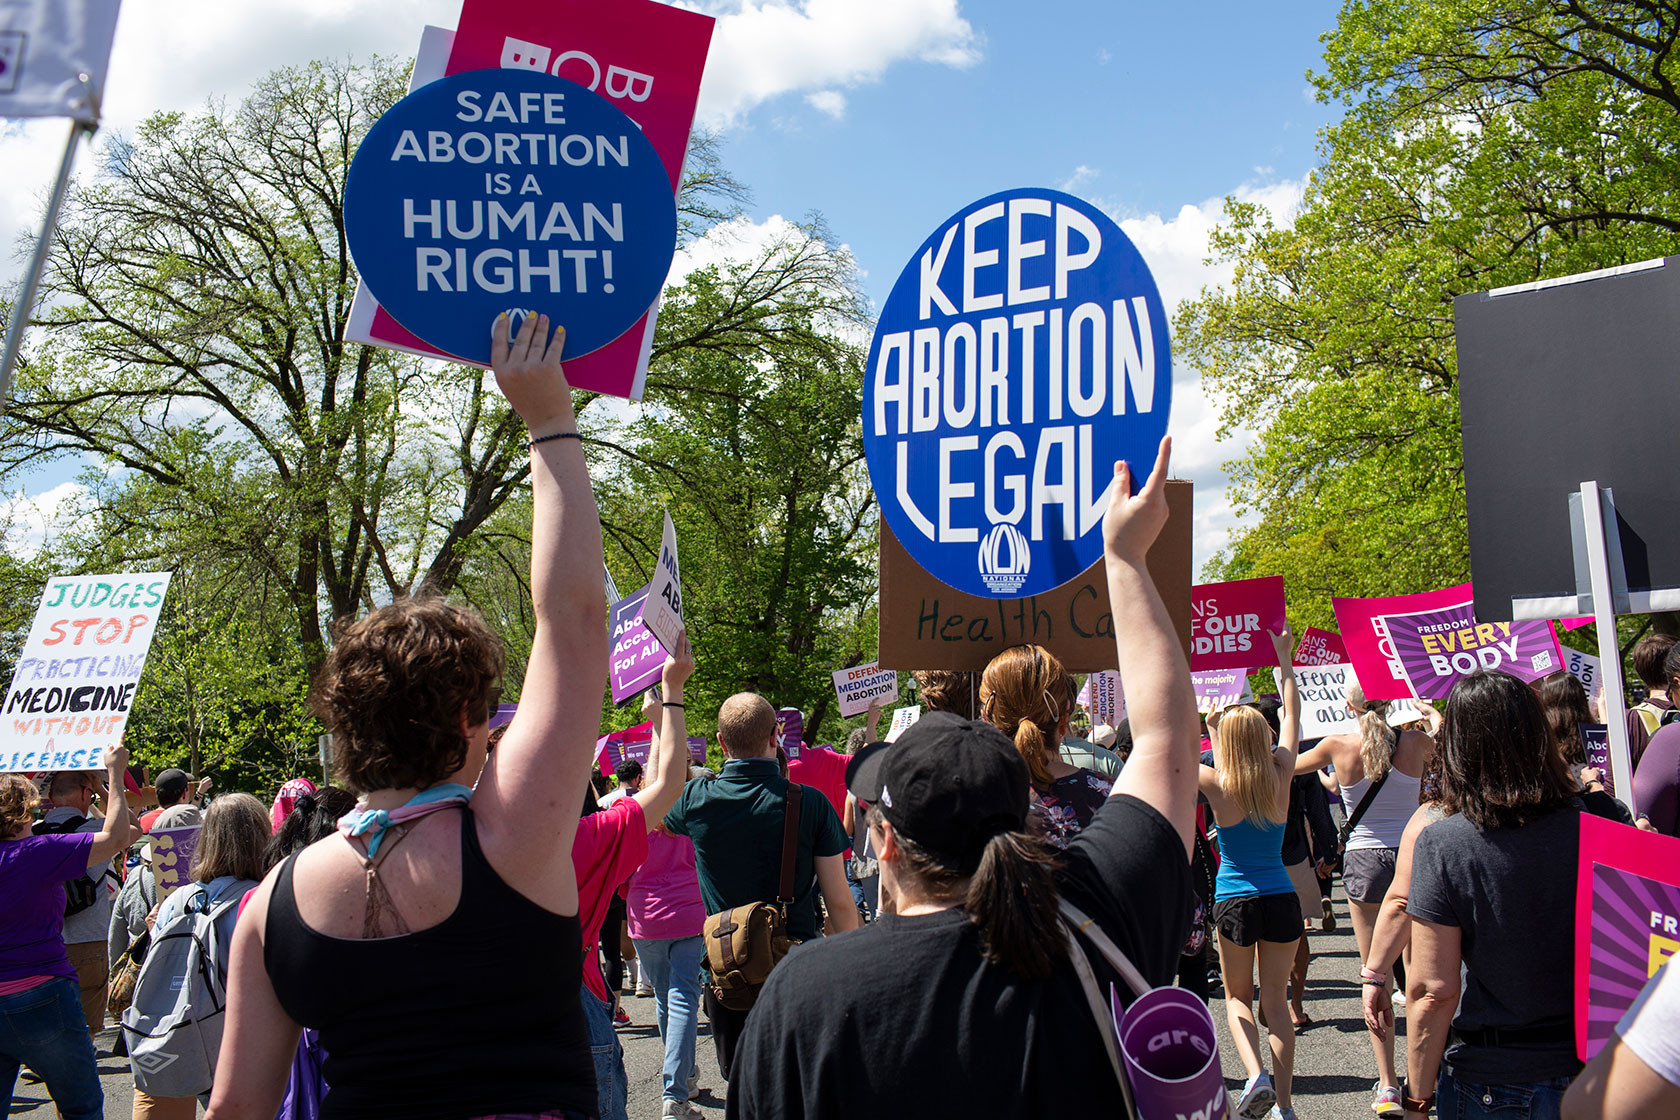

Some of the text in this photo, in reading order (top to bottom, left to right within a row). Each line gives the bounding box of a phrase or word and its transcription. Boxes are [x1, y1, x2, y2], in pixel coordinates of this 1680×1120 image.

[456, 90, 566, 125] SAFE
[391, 130, 630, 167] ABORTION
[485, 173, 543, 196] IS A
[404, 198, 624, 242] HUMAN
[416, 247, 615, 294] RIGHT!
[919, 198, 1102, 321] KEEP
[873, 296, 1155, 436] ABORTION
[896, 424, 1115, 543] LEGAL
[978, 524, 1031, 574] NOW
[47, 581, 164, 609] JUDGES
[1192, 598, 1218, 617] NS
[917, 584, 1116, 642] Health Ca
[1204, 613, 1261, 635] OUR
[1417, 618, 1469, 634] FREEDOM
[42, 614, 149, 646] STOP
[613, 629, 654, 657] Acce
[1191, 633, 1252, 655] DIES
[1420, 621, 1512, 654] EVERY
[15, 652, 146, 682] PRACTICING
[614, 639, 660, 676] For All
[1316, 647, 1341, 664] OUR
[1428, 634, 1519, 677] BODY
[838, 671, 896, 694] MEDICATION
[846, 683, 893, 703] ABORTION
[1191, 673, 1237, 687] he majority
[6, 682, 137, 715] MEDICINE
[14, 715, 124, 737] WITHOUT
[0, 747, 103, 770] LICENSE
[45, 737, 55, 753] A
